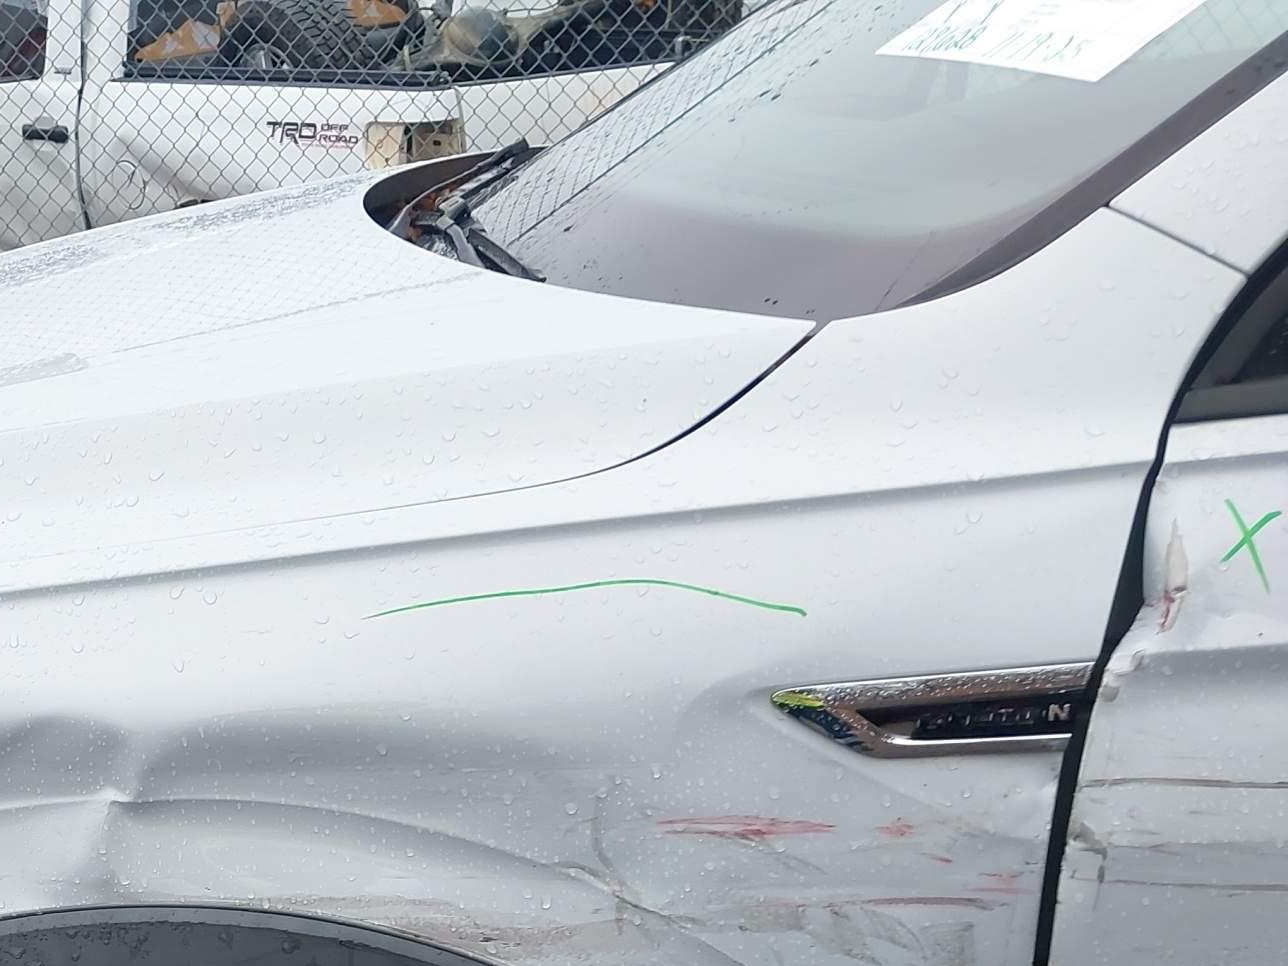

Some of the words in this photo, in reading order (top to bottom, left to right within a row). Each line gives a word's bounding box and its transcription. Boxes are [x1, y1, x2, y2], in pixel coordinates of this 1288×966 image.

[266, 121, 318, 145] TRD
[320, 123, 349, 132] OFF
[318, 133, 359, 144] ROAD
